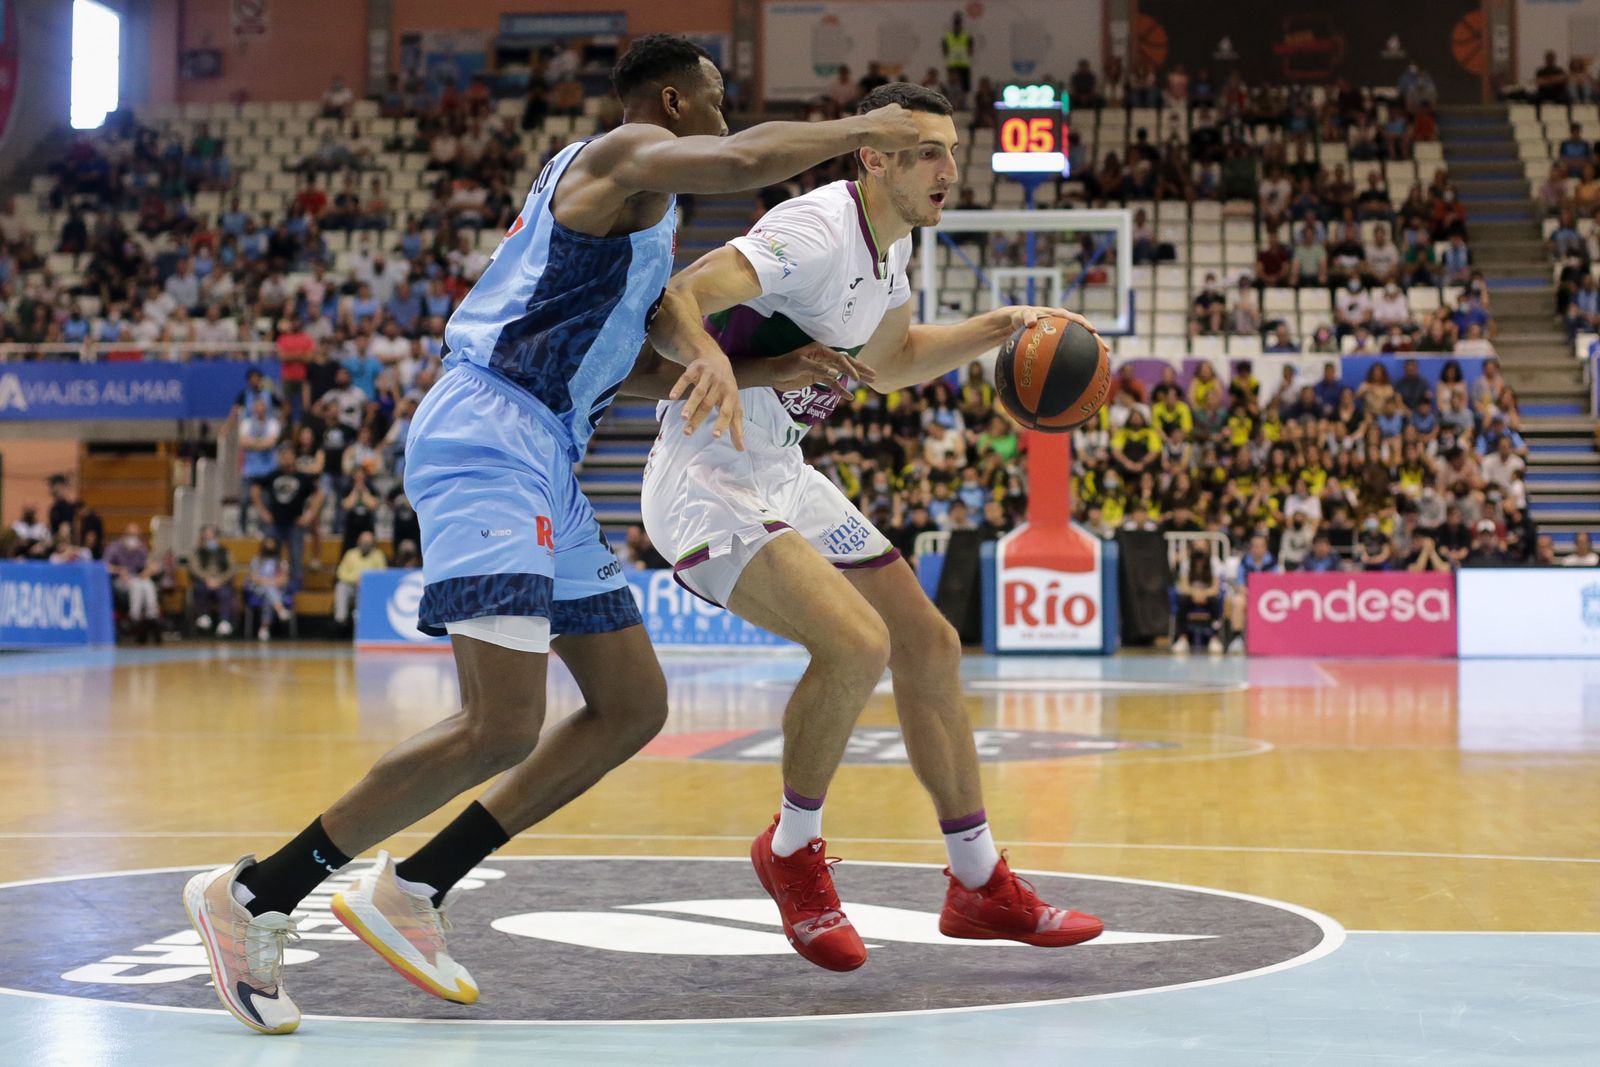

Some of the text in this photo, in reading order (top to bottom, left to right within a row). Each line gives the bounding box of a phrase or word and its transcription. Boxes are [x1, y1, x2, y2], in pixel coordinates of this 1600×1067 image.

[1001, 117, 1055, 153] 05
[28, 380, 99, 406] VIAJES
[101, 380, 183, 405] ALMAR
[828, 526, 870, 555] laga
[1004, 580, 1096, 626] Río
[1258, 580, 1450, 622] endesa
